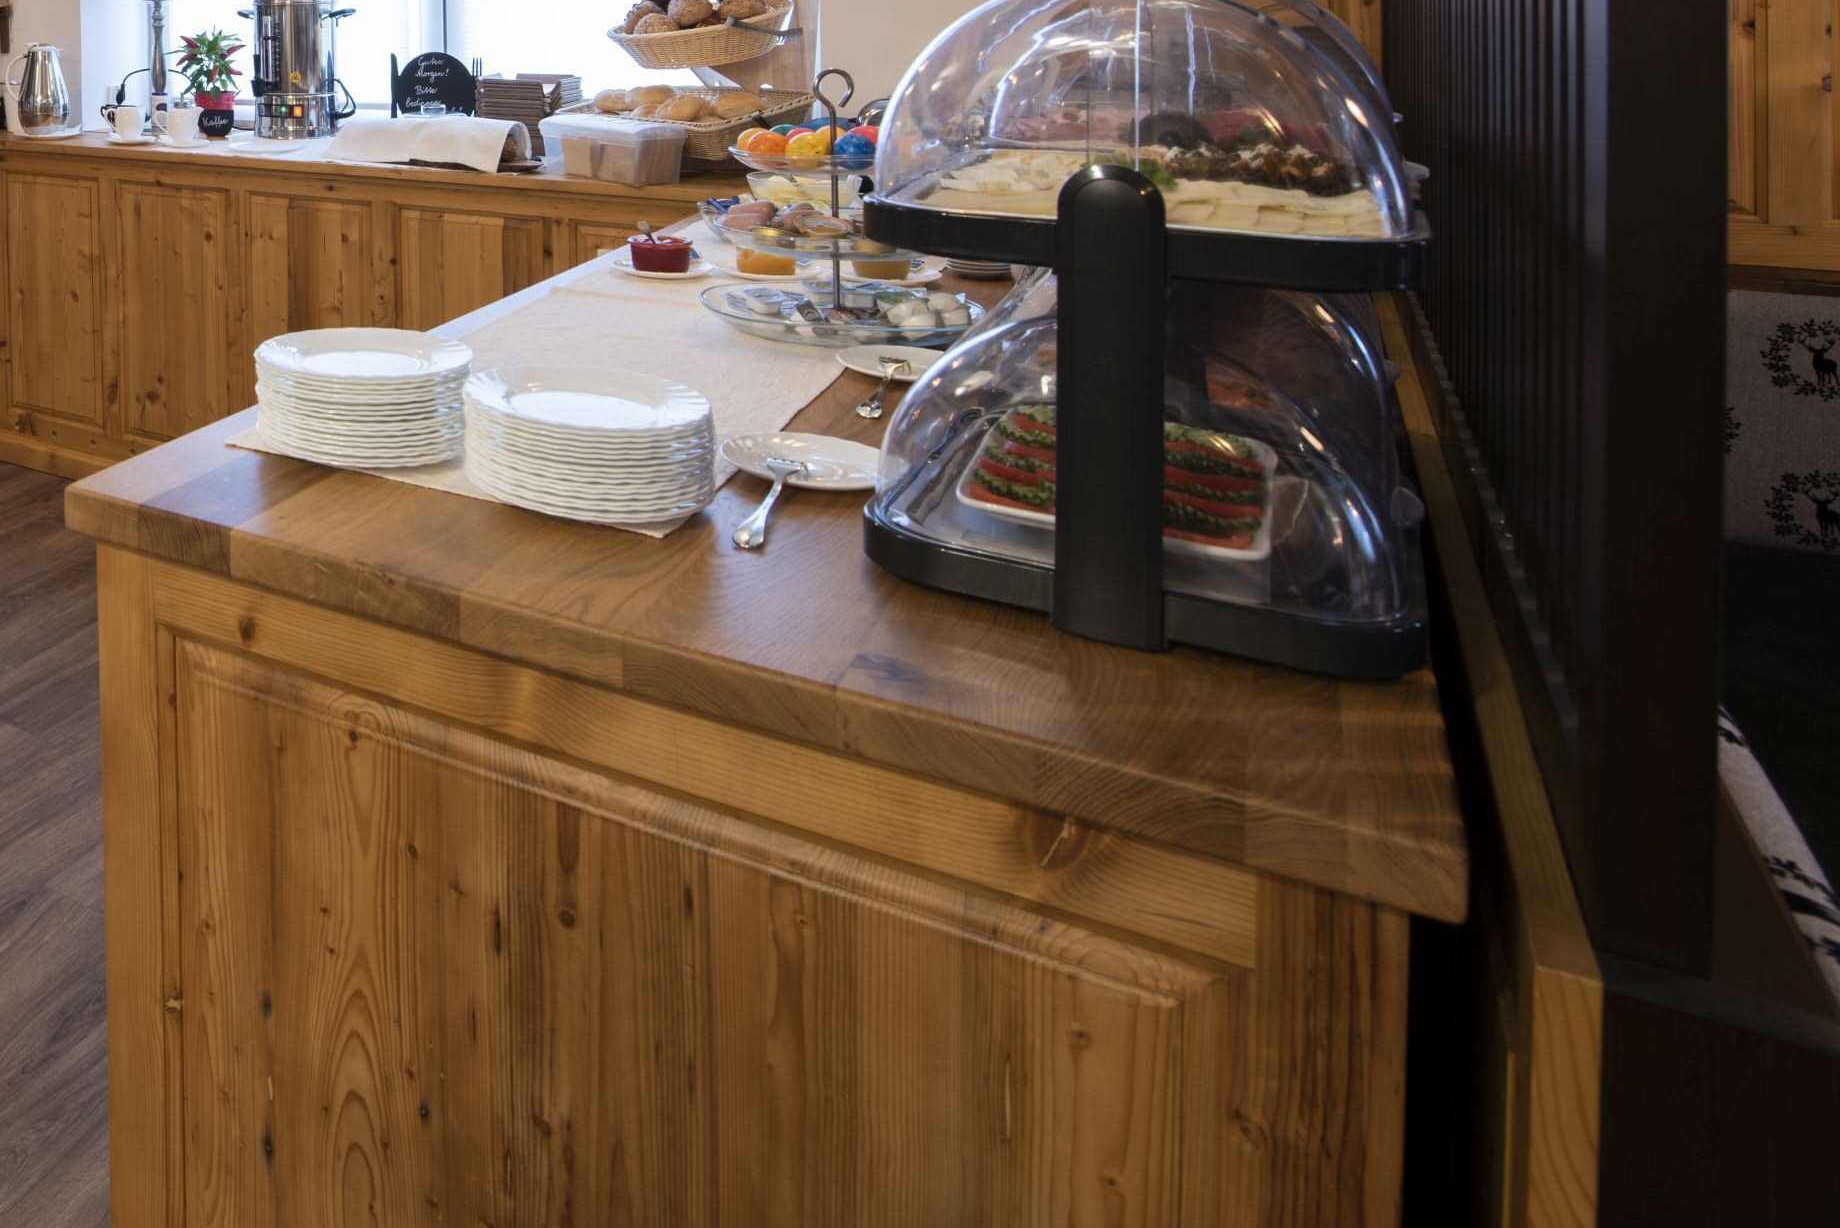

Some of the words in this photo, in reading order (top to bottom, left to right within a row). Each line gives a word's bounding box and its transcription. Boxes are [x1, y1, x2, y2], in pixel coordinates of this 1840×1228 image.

[417, 56, 445, 67] Guten
[414, 68, 449, 83] Morgen!
[414, 84, 439, 95] Bitte
[202, 115, 229, 129] Kaffee
